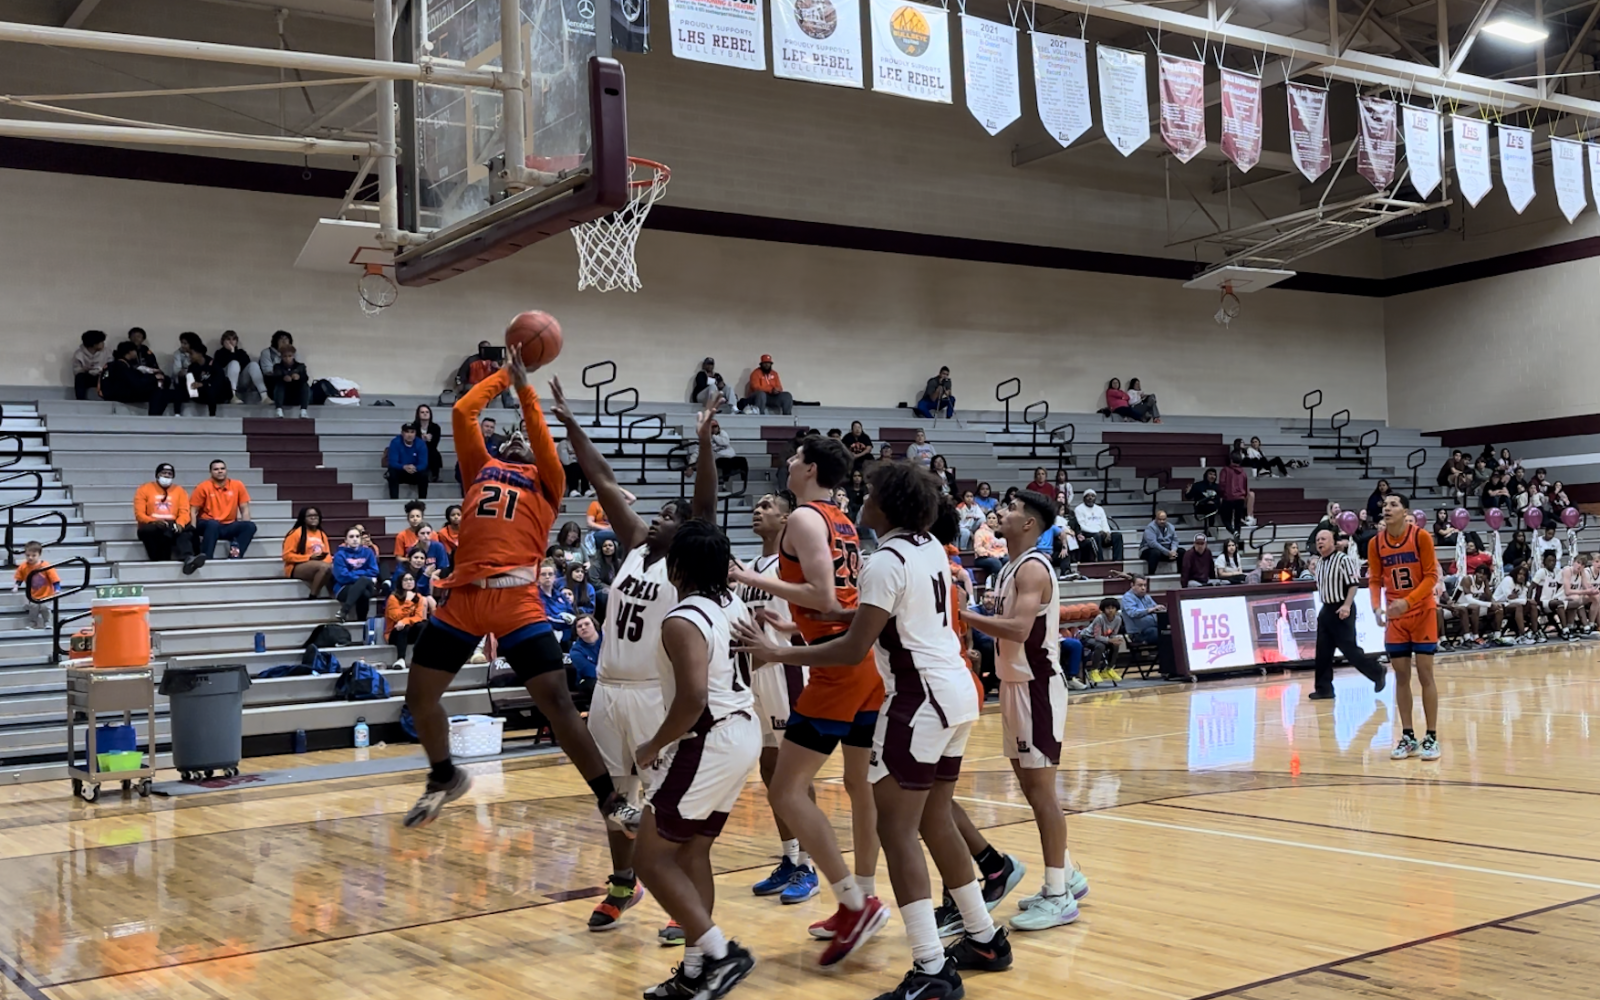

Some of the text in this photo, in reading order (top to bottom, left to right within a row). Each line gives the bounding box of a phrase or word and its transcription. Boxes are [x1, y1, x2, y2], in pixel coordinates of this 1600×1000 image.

[680, 19, 753, 37] PROUDLY SUPPORTS
[980, 23, 999, 35] 2021
[678, 29, 755, 54] LHS REBEL
[784, 38, 850, 55] PROUDLY SUPPORTS
[983, 33, 1013, 46] VOLLEYBALL
[1050, 38, 1068, 49] 2021
[679, 43, 755, 62] VOLLEYBALL
[782, 48, 854, 71] LEE REBEL
[1053, 48, 1083, 59] VOLLEYBALL
[783, 61, 854, 79] VOLLEYBALL
[880, 56, 941, 73] PROUDLY SUPPORTS
[879, 66, 945, 89] LEE REBEL
[879, 79, 946, 98] VOLLEYBALL
[1411, 113, 1428, 132] LHS
[1462, 123, 1479, 141] LHS
[1506, 132, 1524, 149] LHS
[1559, 144, 1575, 161] LHS
[476, 484, 520, 522] 21
[1391, 566, 1414, 591] 13
[930, 571, 948, 628] 4
[616, 598, 647, 643] 45
[1191, 607, 1235, 651] LHS
[1257, 608, 1318, 634] REELS
